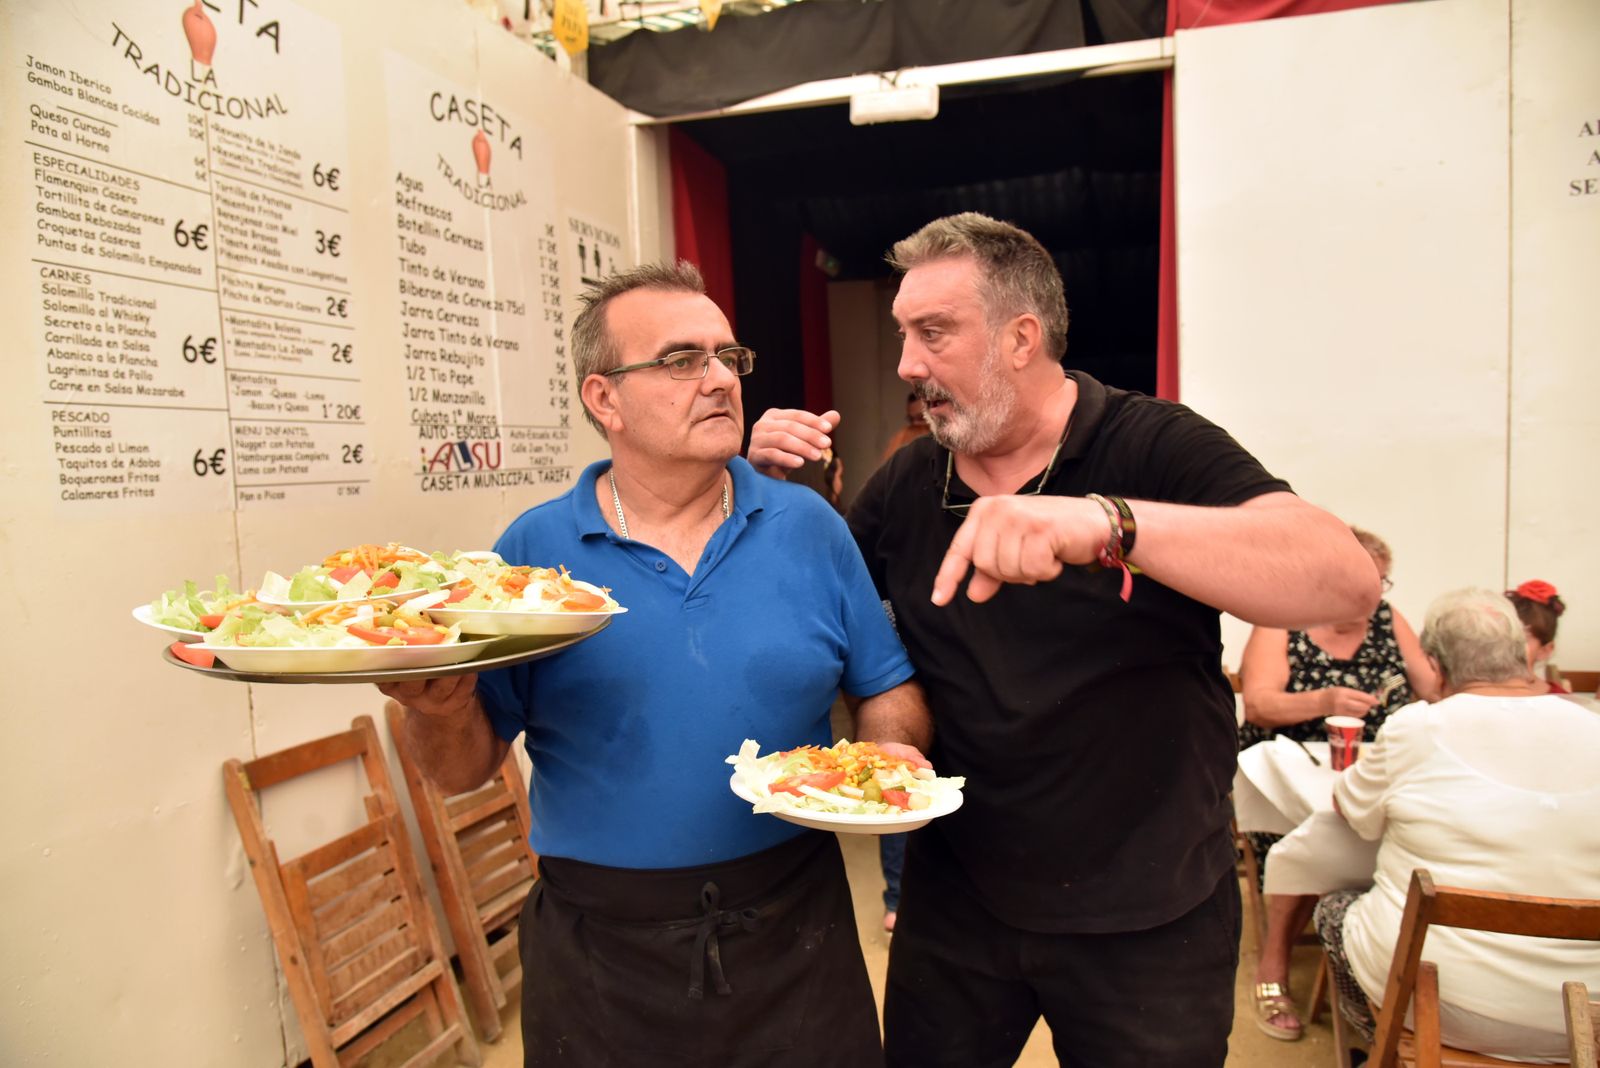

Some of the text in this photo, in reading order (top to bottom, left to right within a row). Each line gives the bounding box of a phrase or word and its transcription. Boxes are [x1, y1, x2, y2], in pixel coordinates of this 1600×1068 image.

[27, 55, 112, 95] Jamon Iberico
[112, 22, 288, 120] TRADICIONAL
[192, 60, 218, 88] LA
[28, 72, 161, 126] Gambas Blancas Cocidas
[31, 104, 112, 139] Queso Curado
[430, 91, 523, 161] CASETA
[32, 120, 110, 153] Pata al Horno
[34, 153, 141, 191] ESPECIALIDADES
[313, 163, 341, 192] 6€
[397, 171, 424, 194] Agua
[438, 152, 528, 212] TRADICIONAL
[35, 169, 138, 205] Flamenquin Casero
[36, 186, 166, 227] Tortillita de Camarones
[37, 202, 142, 236] Gambas Rebozadas
[396, 191, 453, 222] Refrescos
[38, 218, 141, 250] Croquetas Caseras
[174, 220, 210, 252] 6€
[315, 231, 342, 257] 3€
[397, 213, 485, 252] Botellin Cerveza
[398, 235, 427, 257] Tubo
[38, 234, 202, 276] Puntas de Solomillo Empanadas
[41, 267, 93, 285] CARNES
[398, 257, 486, 291] Tinto de Verano
[42, 284, 157, 310] Solomillo Tradicional
[327, 297, 348, 318] 2€
[399, 278, 444, 301] Biberon
[447, 289, 460, 305] de
[463, 292, 505, 313] Cerveza
[43, 300, 151, 328] Solomillo al Whisky
[45, 316, 157, 339] Secreto a la Plancha
[400, 301, 480, 328] Jarra Cerveza
[45, 332, 151, 352] Carrillada en Salsa
[183, 335, 218, 365] 6€
[403, 322, 520, 352] Jarra Tinto de Verano
[48, 348, 159, 368] Abanico a la Plancha
[332, 343, 353, 364] 2€
[405, 344, 485, 370] Jarra Rebujito
[48, 363, 154, 382] Lagrimitas de Pollo
[407, 365, 475, 388] 1/2 Tio Pepe
[49, 379, 133, 395] Carne en Salsa
[409, 387, 487, 406] 1/2 Manzanilla
[53, 410, 111, 424] PESCADO
[411, 408, 450, 425] Cubata
[467, 411, 498, 426] Marca
[54, 426, 112, 439] Puntillitas
[56, 442, 150, 455] Pescado al Limon
[342, 444, 364, 464] 2€
[58, 457, 162, 472] Taquitos de Adobo
[193, 448, 226, 477] 6€
[60, 473, 125, 488] Boquerones
[421, 467, 572, 493] CASETA MUNICIPAL TARIFA
[61, 488, 120, 502] Calamares
